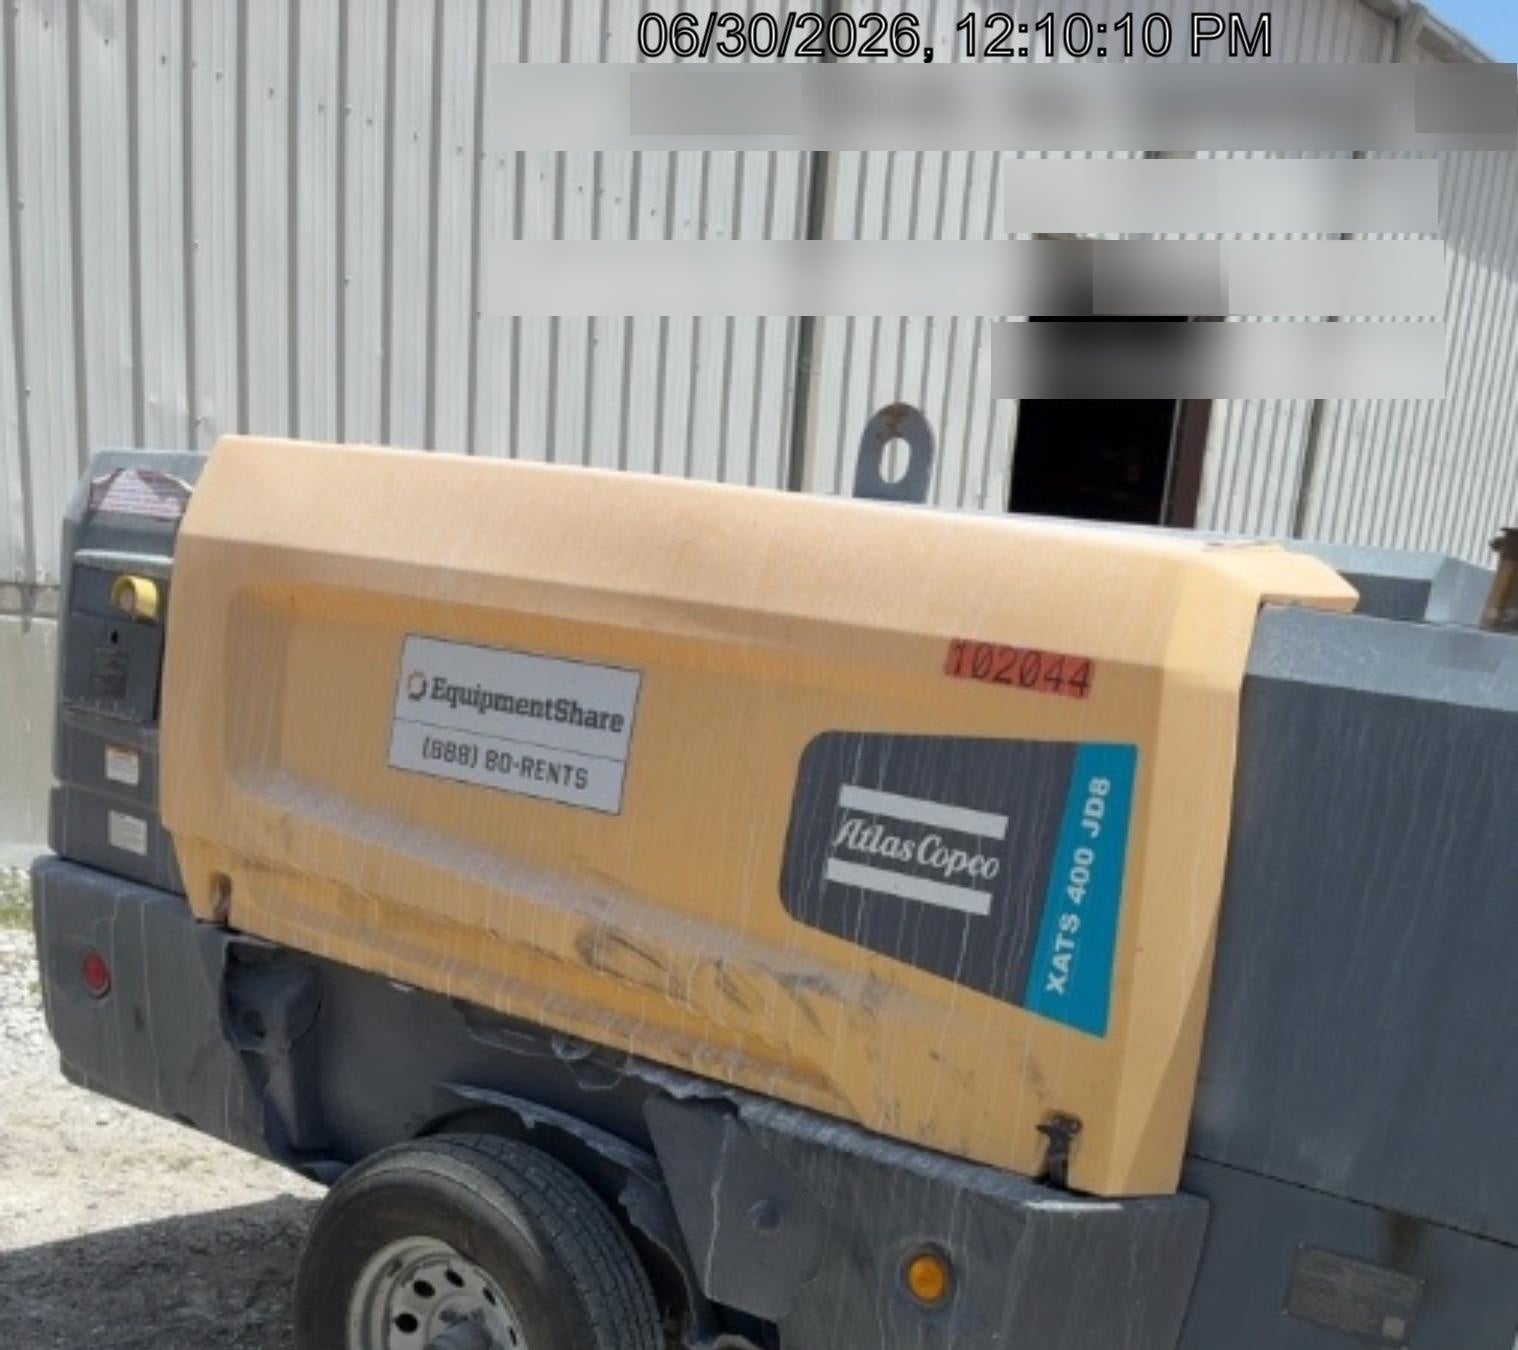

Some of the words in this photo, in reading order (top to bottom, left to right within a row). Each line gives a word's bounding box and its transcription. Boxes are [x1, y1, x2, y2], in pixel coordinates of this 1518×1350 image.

[951, 641, 1093, 697] 102044
[431, 677, 625, 732] EquipmentShare
[422, 736, 478, 768] (888)
[485, 750, 589, 789] 80-RENTS
[832, 818, 916, 863] Atlas
[917, 836, 999, 879] Copco
[1046, 912, 1082, 994] XATS
[1066, 847, 1095, 905] 400
[1082, 777, 1111, 838] JD8
